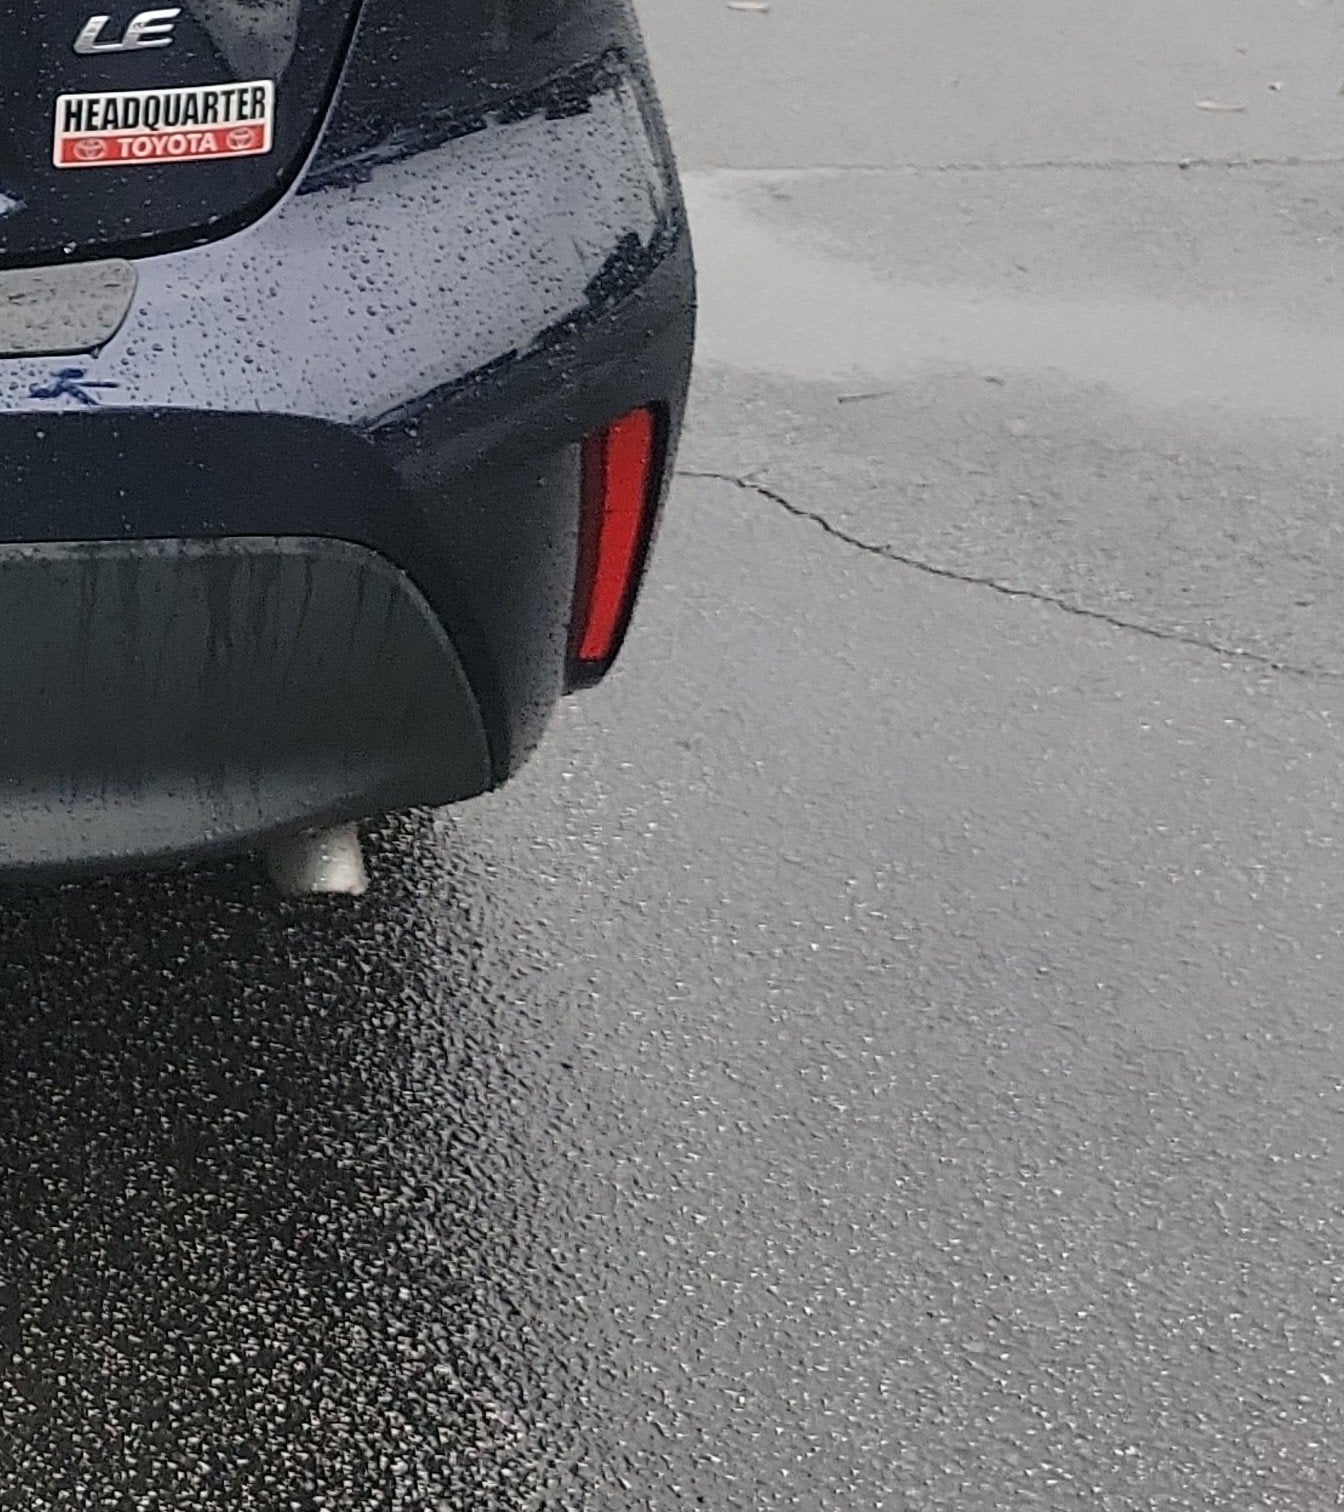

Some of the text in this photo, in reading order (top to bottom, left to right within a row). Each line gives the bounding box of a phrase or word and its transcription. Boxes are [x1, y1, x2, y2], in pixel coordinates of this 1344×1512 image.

[73, 7, 182, 54] LE
[62, 85, 267, 132] HEADQUARTER
[116, 133, 217, 158] TOYOTA
